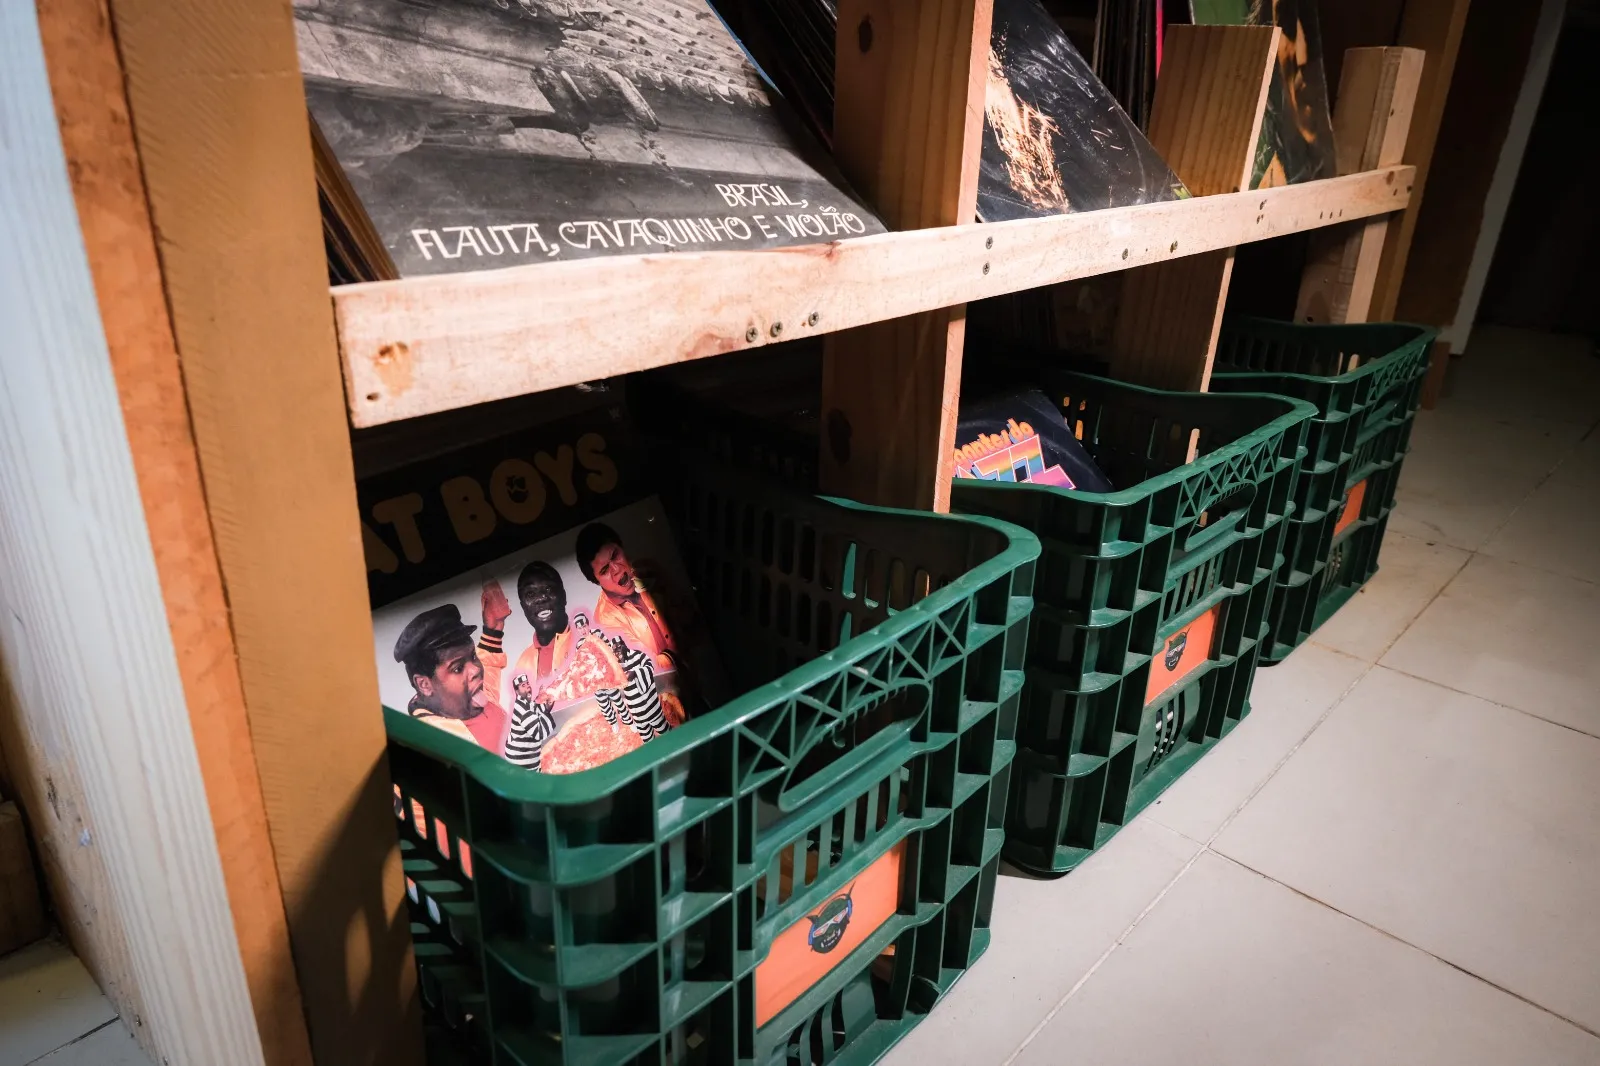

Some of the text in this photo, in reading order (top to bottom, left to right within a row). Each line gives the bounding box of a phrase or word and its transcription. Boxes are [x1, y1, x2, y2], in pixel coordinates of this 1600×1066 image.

[715, 183, 809, 209] BRASIL,
[411, 205, 866, 261] FLAUTA, CAVAQUINHO E VIOLÃO
[440, 432, 619, 545] BOYS
